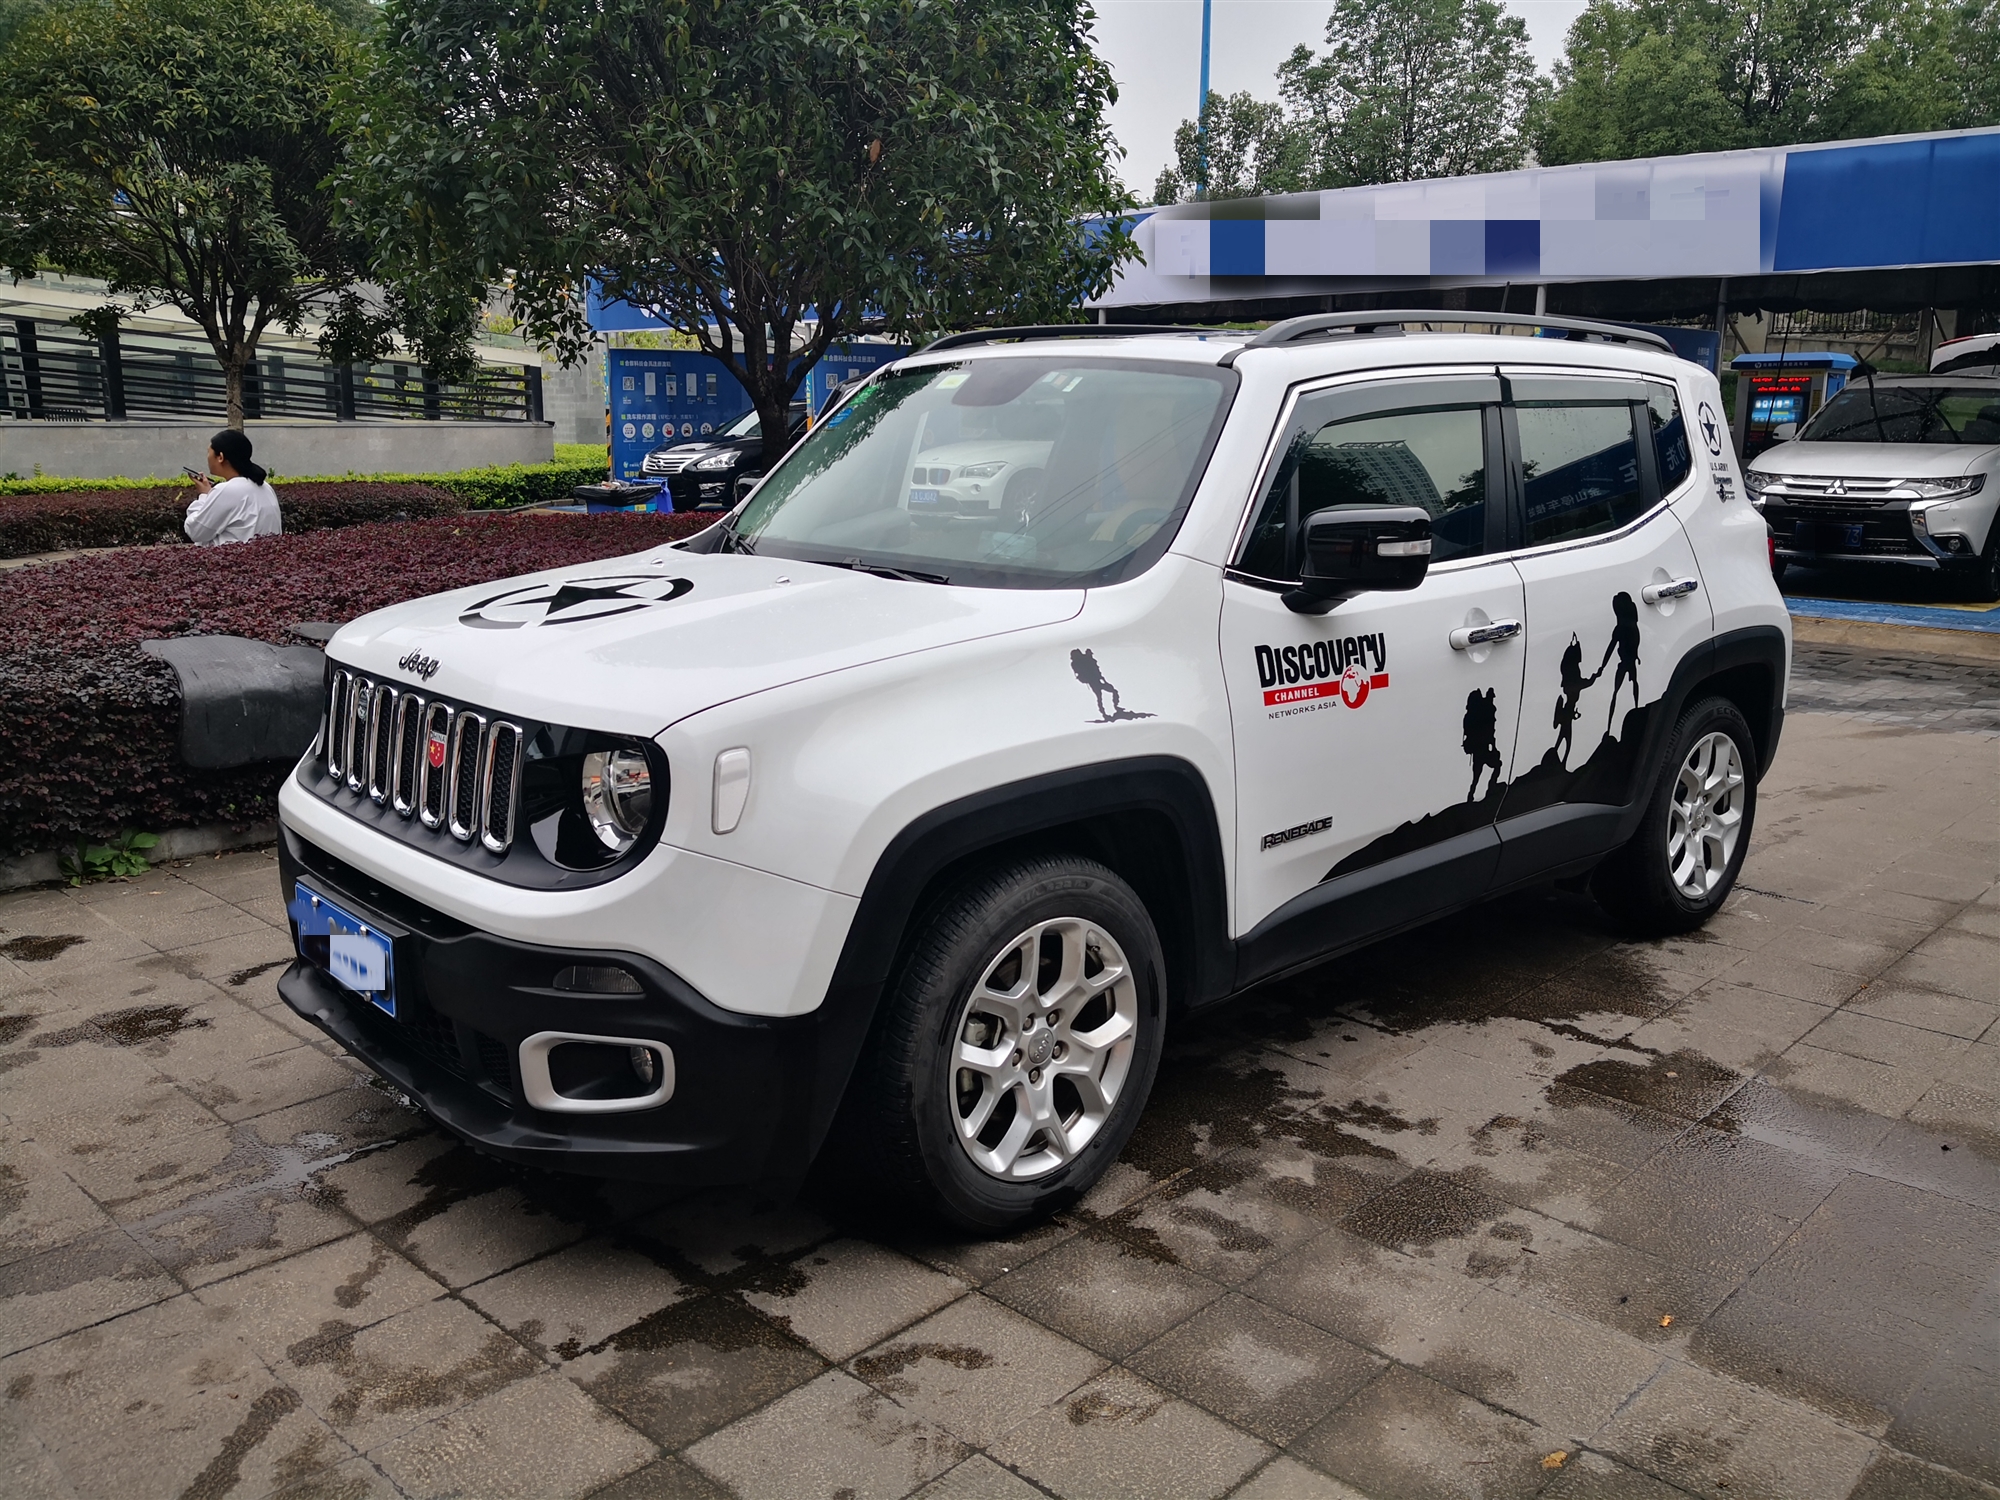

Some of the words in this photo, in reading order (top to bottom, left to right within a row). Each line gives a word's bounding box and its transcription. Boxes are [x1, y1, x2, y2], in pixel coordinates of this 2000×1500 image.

[398, 646, 442, 682] Jeep
[1274, 687, 1320, 702] CHANNEL
[1268, 704, 1316, 720] NETWORKS
[1317, 700, 1338, 711] ASIA
[1260, 815, 1333, 853] RENEGADE
